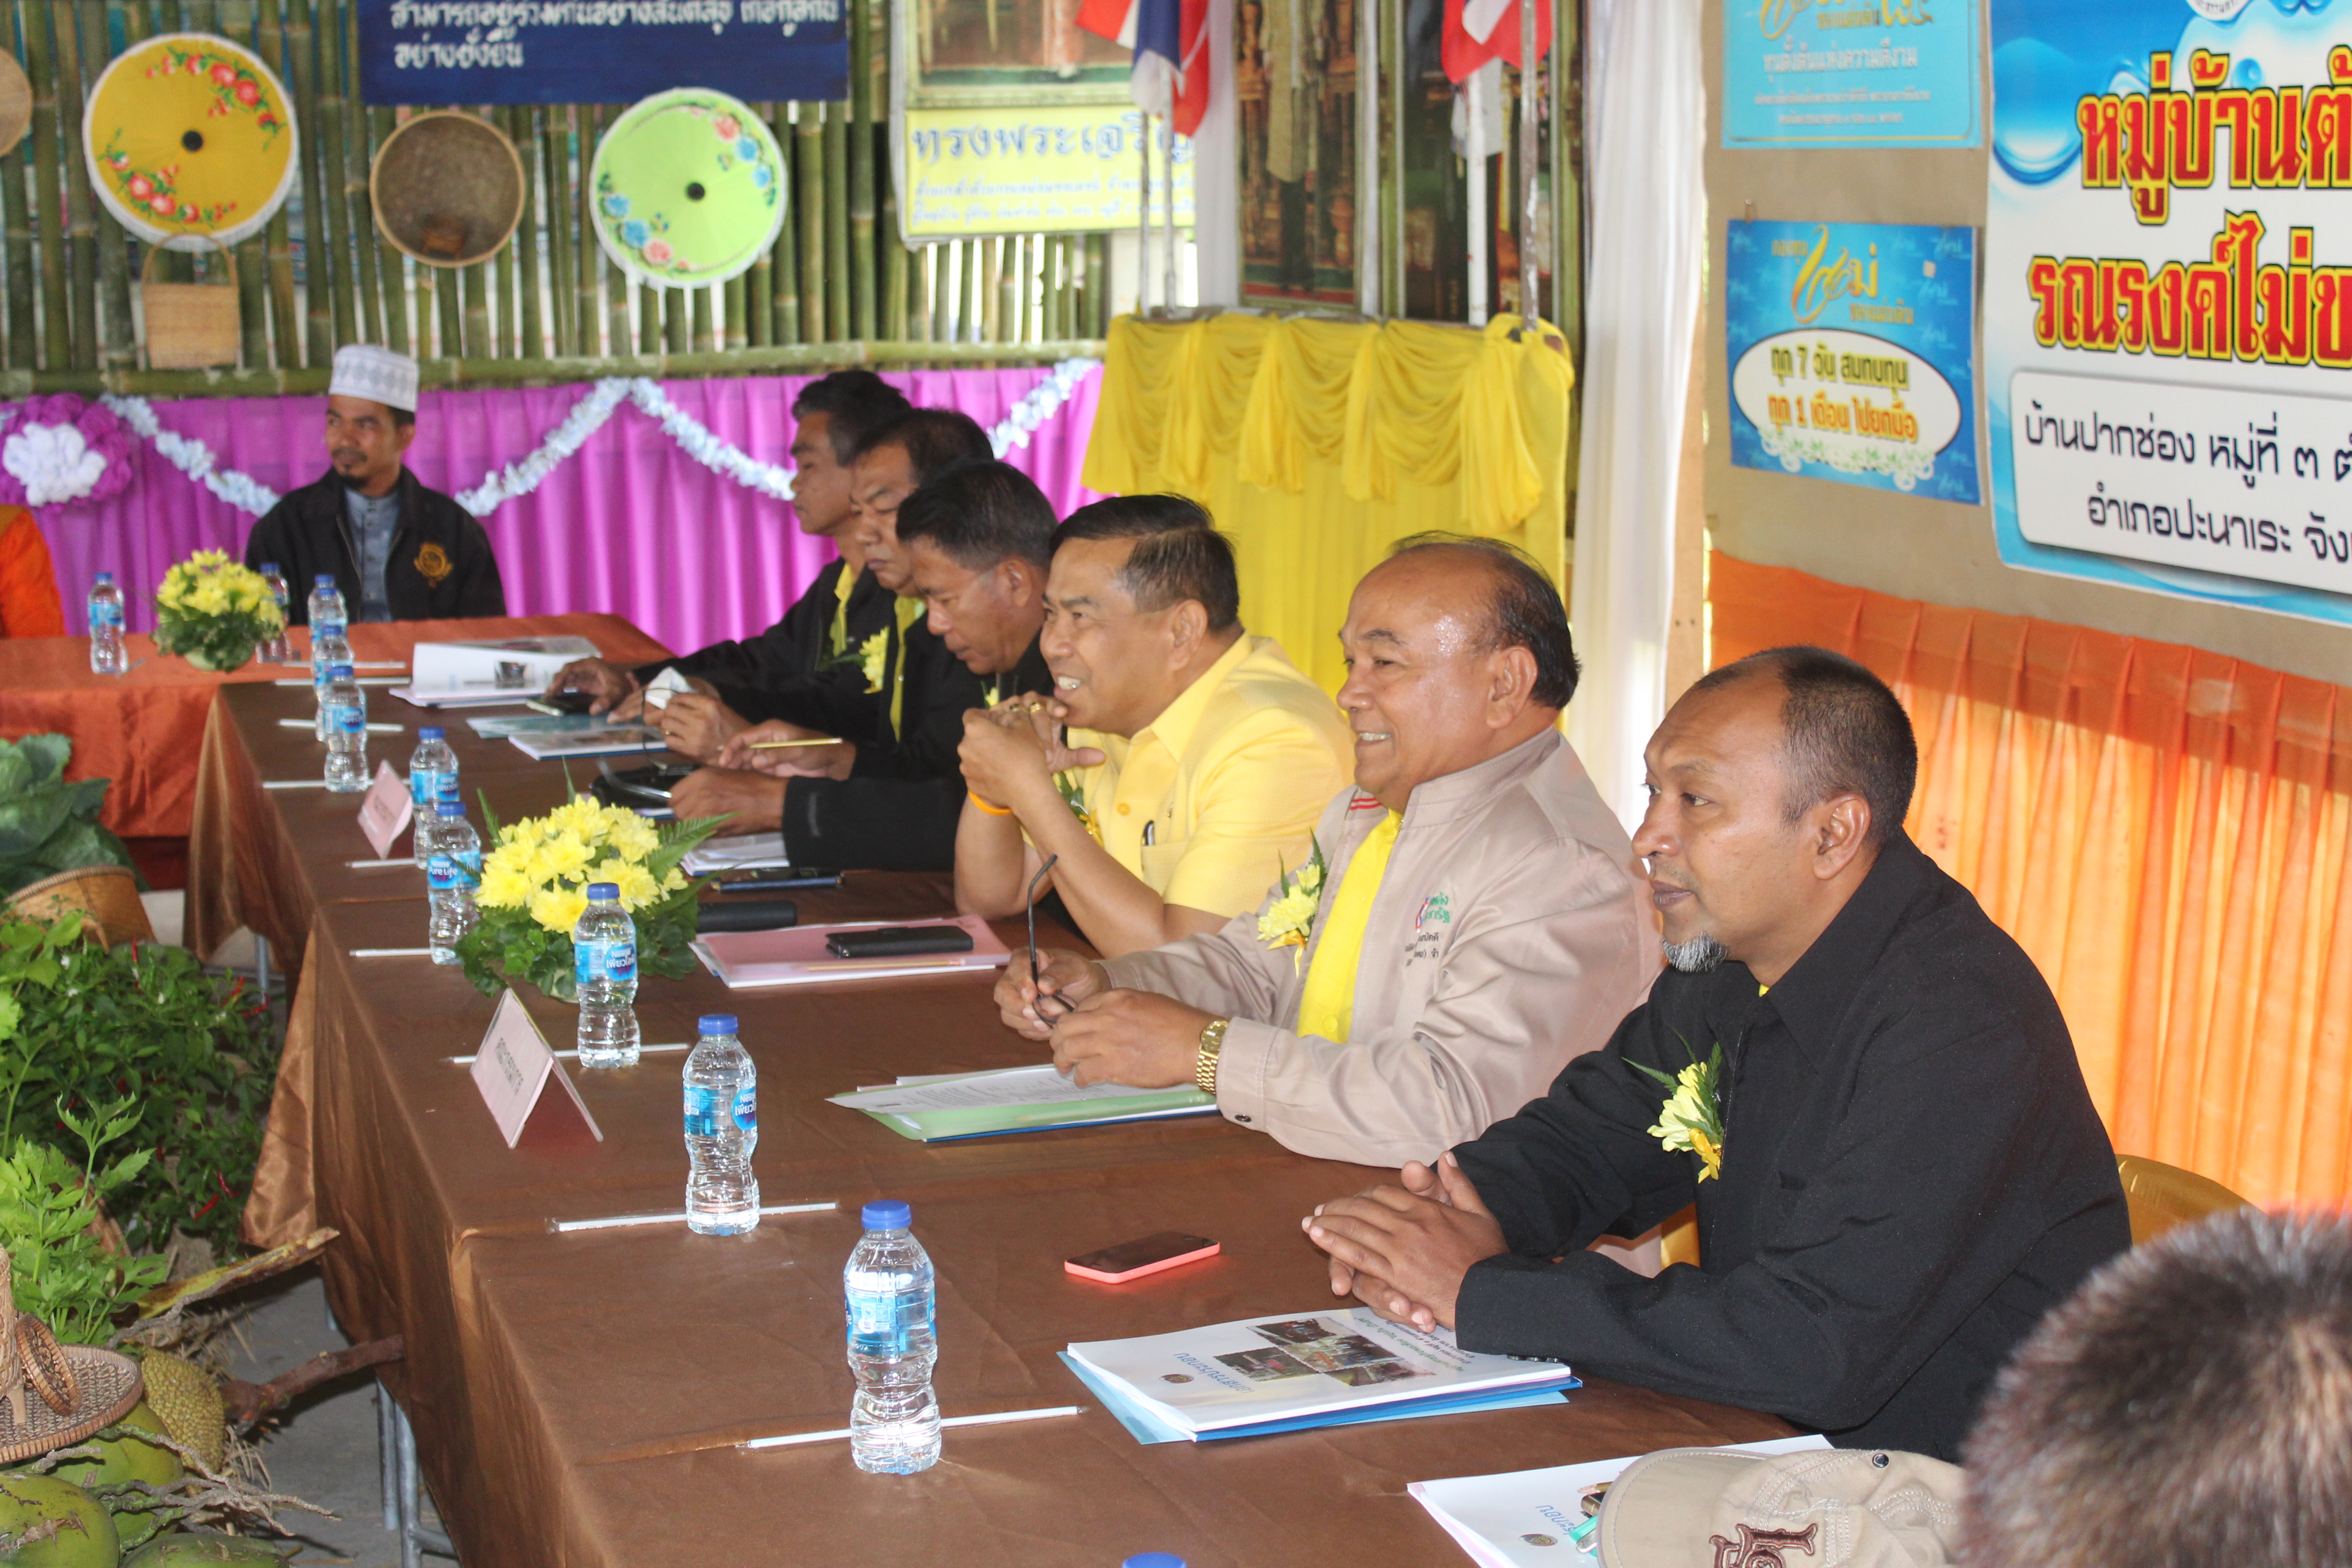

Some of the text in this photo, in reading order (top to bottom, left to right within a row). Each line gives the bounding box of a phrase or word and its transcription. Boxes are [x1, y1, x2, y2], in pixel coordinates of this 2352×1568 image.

[1796, 343, 1808, 379] 7
[1813, 341, 1836, 382] วัน
[2026, 399, 2195, 463] บ้านปากช่อง
[2209, 411, 2278, 489] หมู่ที่
[2294, 446, 2318, 479] ๓
[2088, 480, 2352, 563] อำเภอปะนาเระ จัง
